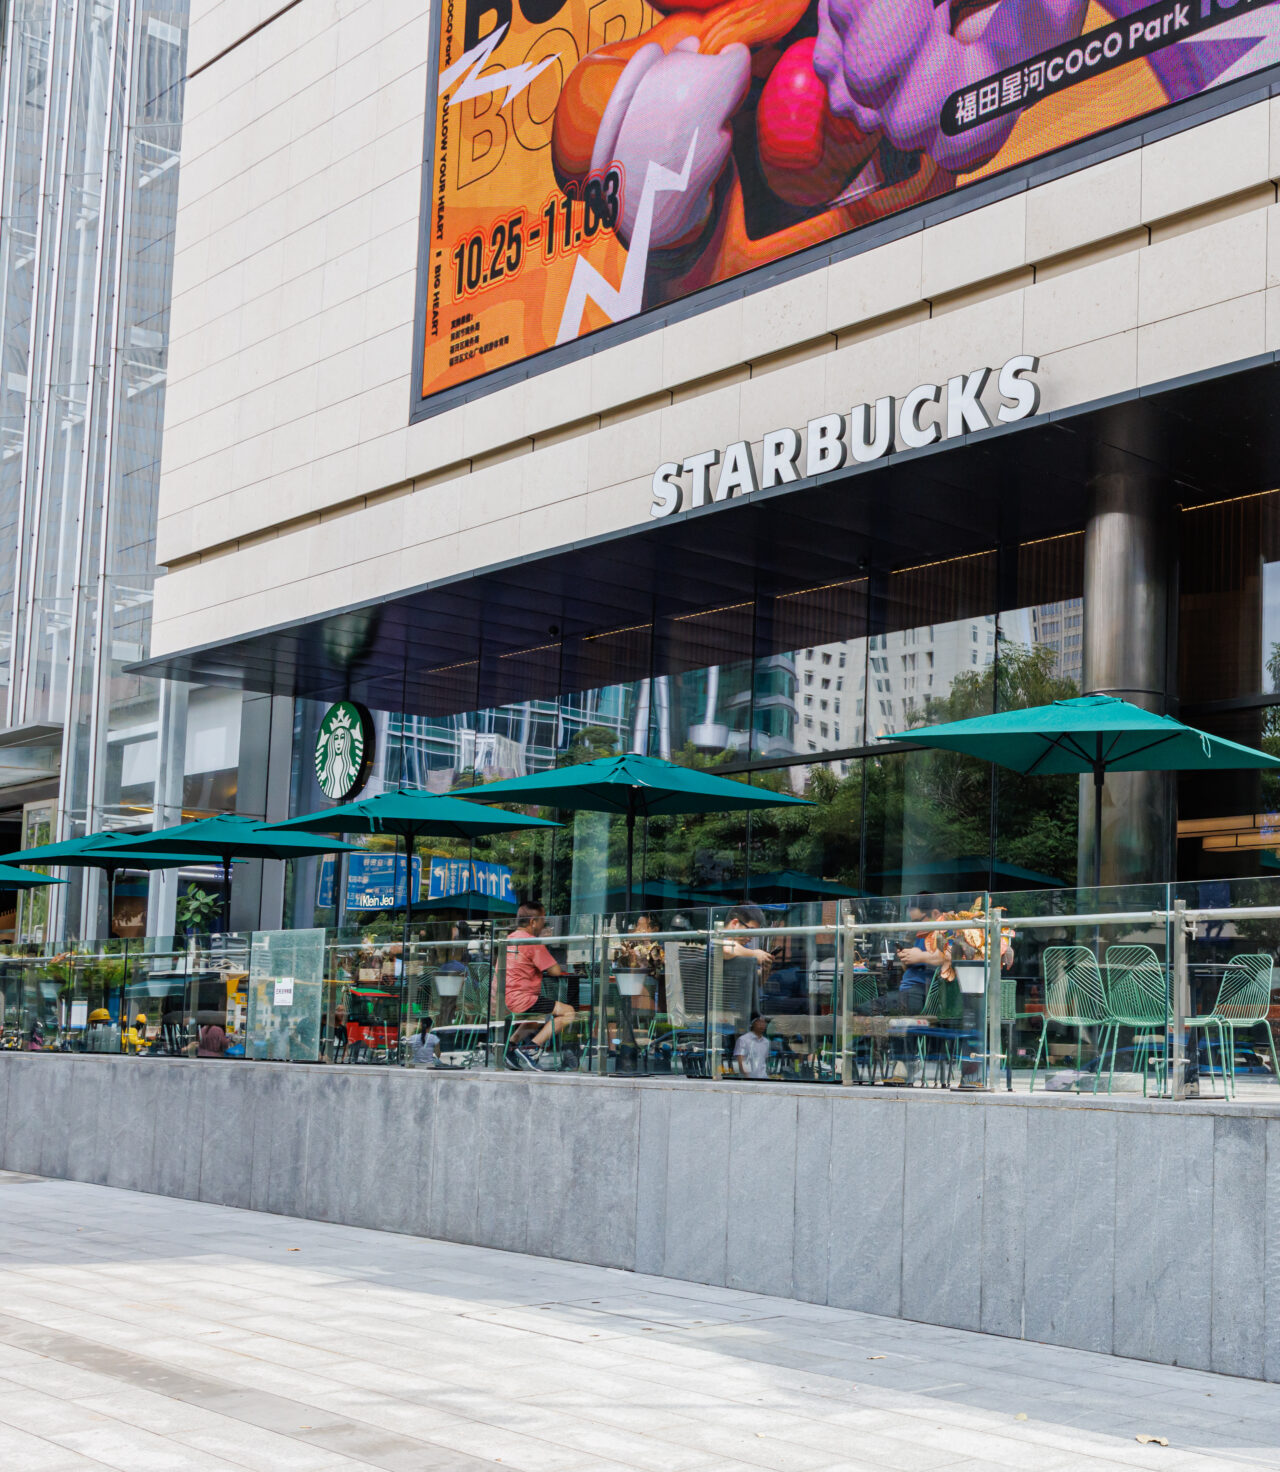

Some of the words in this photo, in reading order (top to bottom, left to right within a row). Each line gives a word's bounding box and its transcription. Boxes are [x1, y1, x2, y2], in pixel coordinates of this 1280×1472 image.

[1128, 4, 1190, 50] Park
[440, 94, 450, 151] FOLLOW
[439, 152, 447, 195] YOUR
[436, 195, 445, 240] HEART
[433, 264, 441, 289] BIG
[431, 291, 440, 336] HEART
[650, 354, 1041, 519] STARBUCKS
